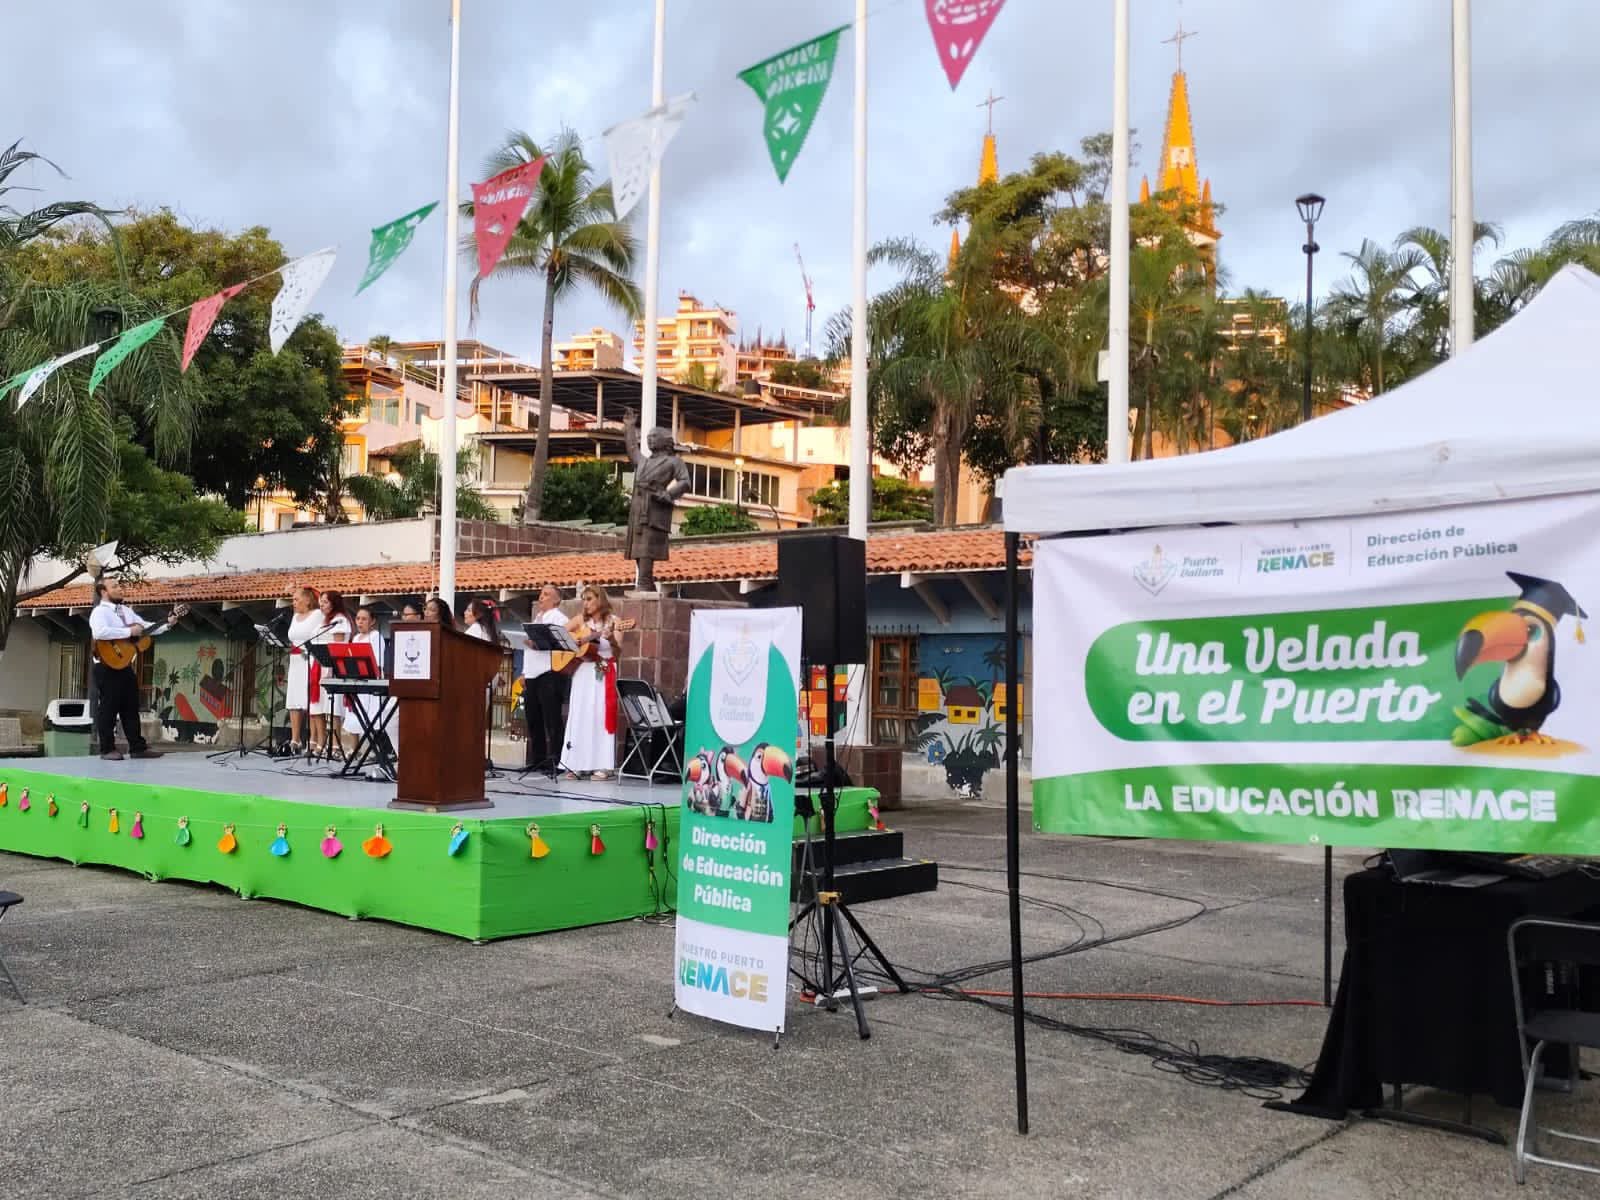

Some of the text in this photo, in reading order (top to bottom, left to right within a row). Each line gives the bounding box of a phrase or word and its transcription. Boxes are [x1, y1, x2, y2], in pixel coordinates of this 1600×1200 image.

[1367, 525, 1465, 547] Dirección de
[1257, 551, 1335, 573] RENACE
[1367, 542, 1518, 567] Educación Pública
[1136, 619, 1428, 676] Una Velada
[1127, 677, 1442, 725] en el Puerto
[1124, 781, 1556, 823] LA EDUCACIÓN RENACE
[692, 826, 767, 855] Dirección
[683, 853, 783, 887] de Educación
[694, 884, 752, 913] Pública
[721, 952, 765, 969] PUERTO
